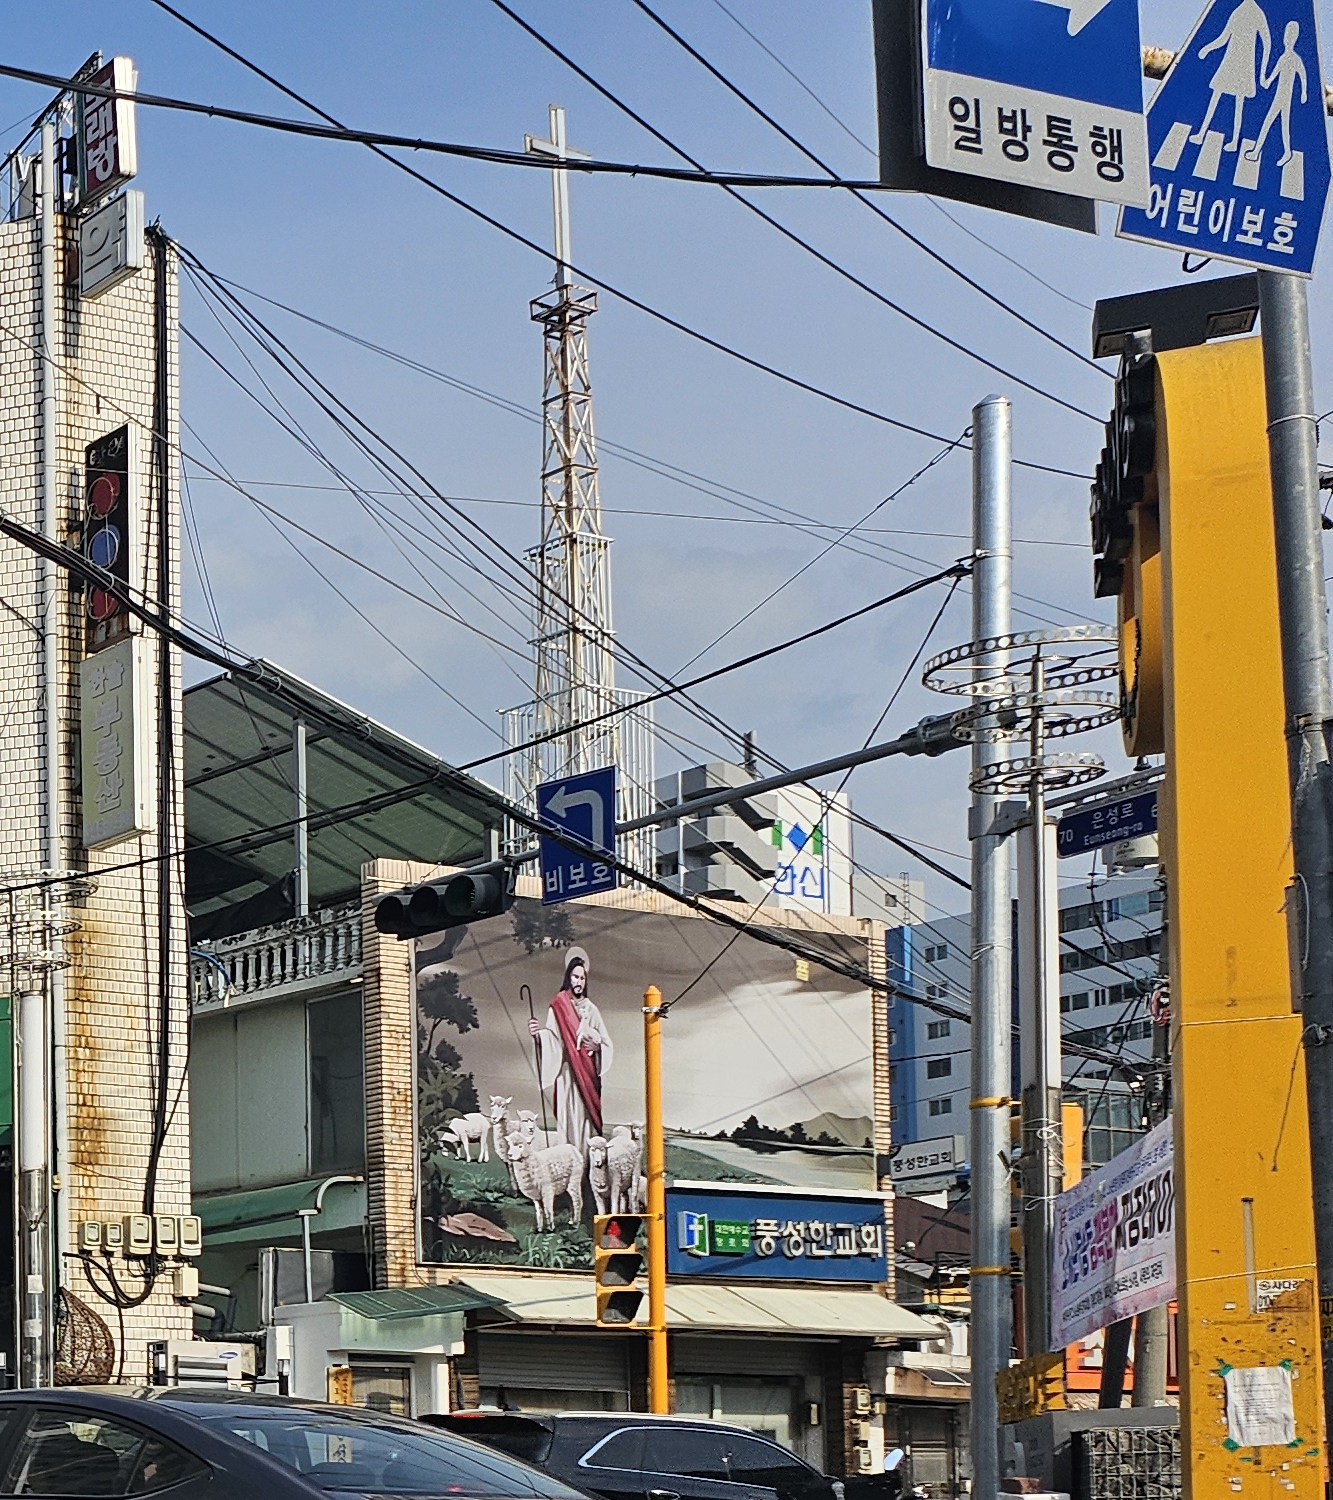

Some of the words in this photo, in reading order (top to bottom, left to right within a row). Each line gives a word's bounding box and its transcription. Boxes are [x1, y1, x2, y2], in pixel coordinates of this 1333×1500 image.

[947, 96, 1124, 183] 일방통행
[1145, 183, 1298, 254] 어린이보호
[90, 699, 123, 814] 부동산
[1058, 828, 1074, 845] 70
[1091, 802, 1135, 830] 은성로
[1083, 821, 1144, 846] Eunseong-ro
[545, 860, 612, 894] 비보호
[773, 861, 826, 899] 한신
[892, 1151, 952, 1173] 풍성한교회
[754, 1218, 884, 1258] 풍성한교회
